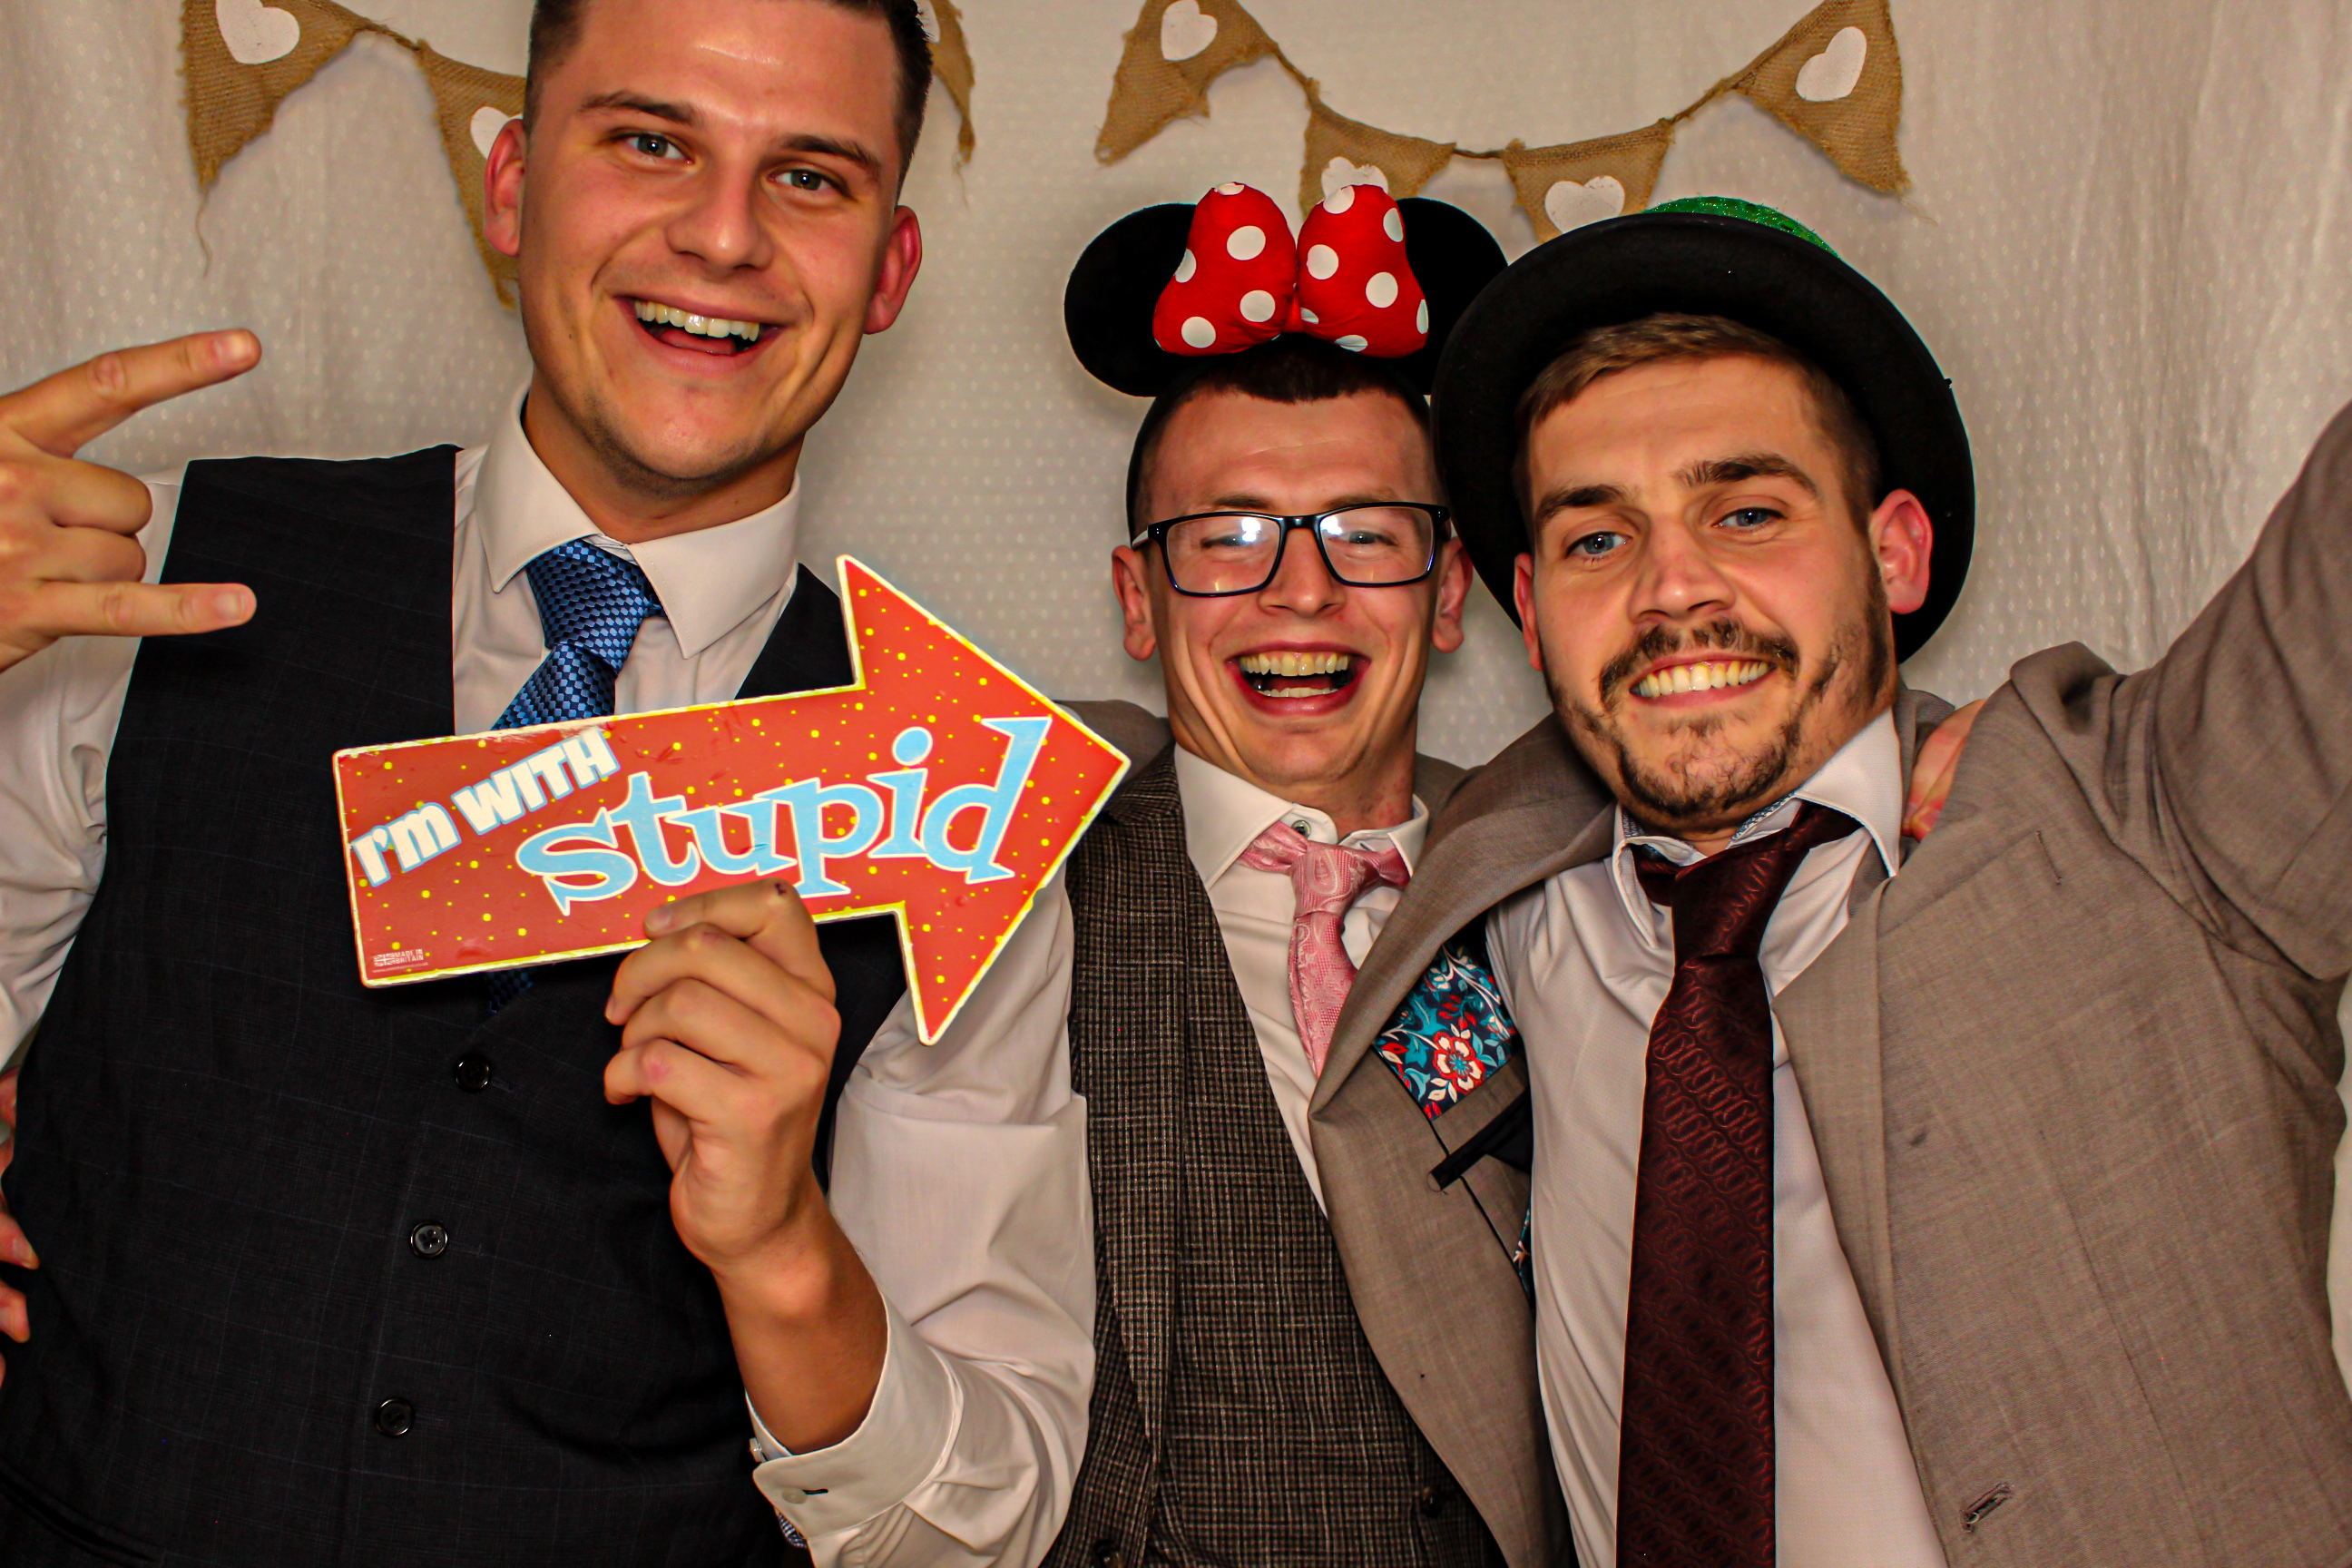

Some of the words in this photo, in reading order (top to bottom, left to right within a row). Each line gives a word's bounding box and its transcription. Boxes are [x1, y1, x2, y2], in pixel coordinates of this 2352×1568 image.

[451, 727, 620, 835] WITH
[516, 717, 1053, 916] stupid
[394, 950, 414, 958] MADE
[395, 955, 424, 965] BRITAIN
